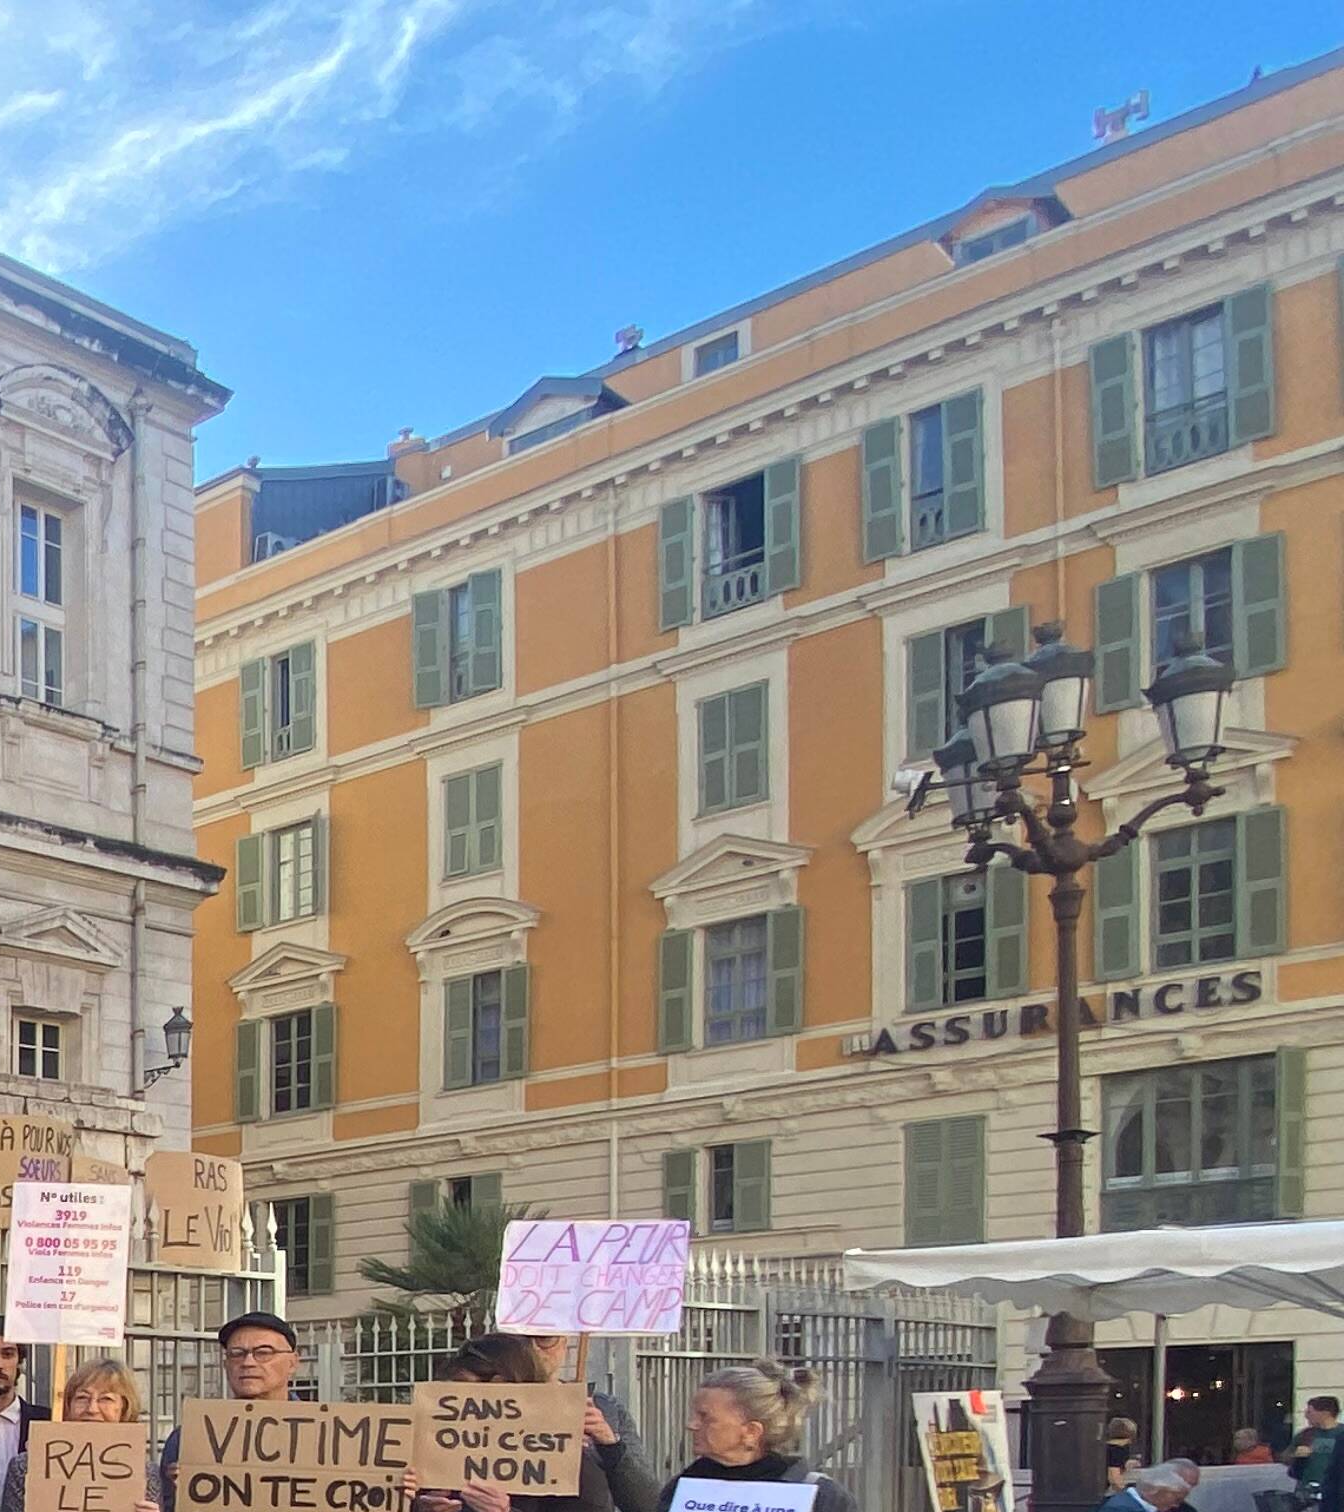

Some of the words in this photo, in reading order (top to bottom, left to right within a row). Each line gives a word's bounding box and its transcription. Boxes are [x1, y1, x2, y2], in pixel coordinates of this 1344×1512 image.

[194, 1158, 227, 1192] RAS
[55, 1210, 87, 1221] 3919
[507, 1223, 580, 1262] LA
[587, 1223, 687, 1265] PEUR
[58, 1265, 82, 1276] 119
[504, 1264, 568, 1288] DOIT
[581, 1264, 683, 1288] CHANGER
[500, 1290, 571, 1327] DE
[578, 1287, 683, 1329] CAMP
[432, 1395, 522, 1421] SANS
[204, 1403, 412, 1468] VICTIME
[435, 1426, 490, 1449] OUI
[498, 1429, 573, 1453] C'EST
[45, 1440, 133, 1481] RAS
[58, 1485, 111, 1512] LE
[685, 1499, 715, 1512] Que
